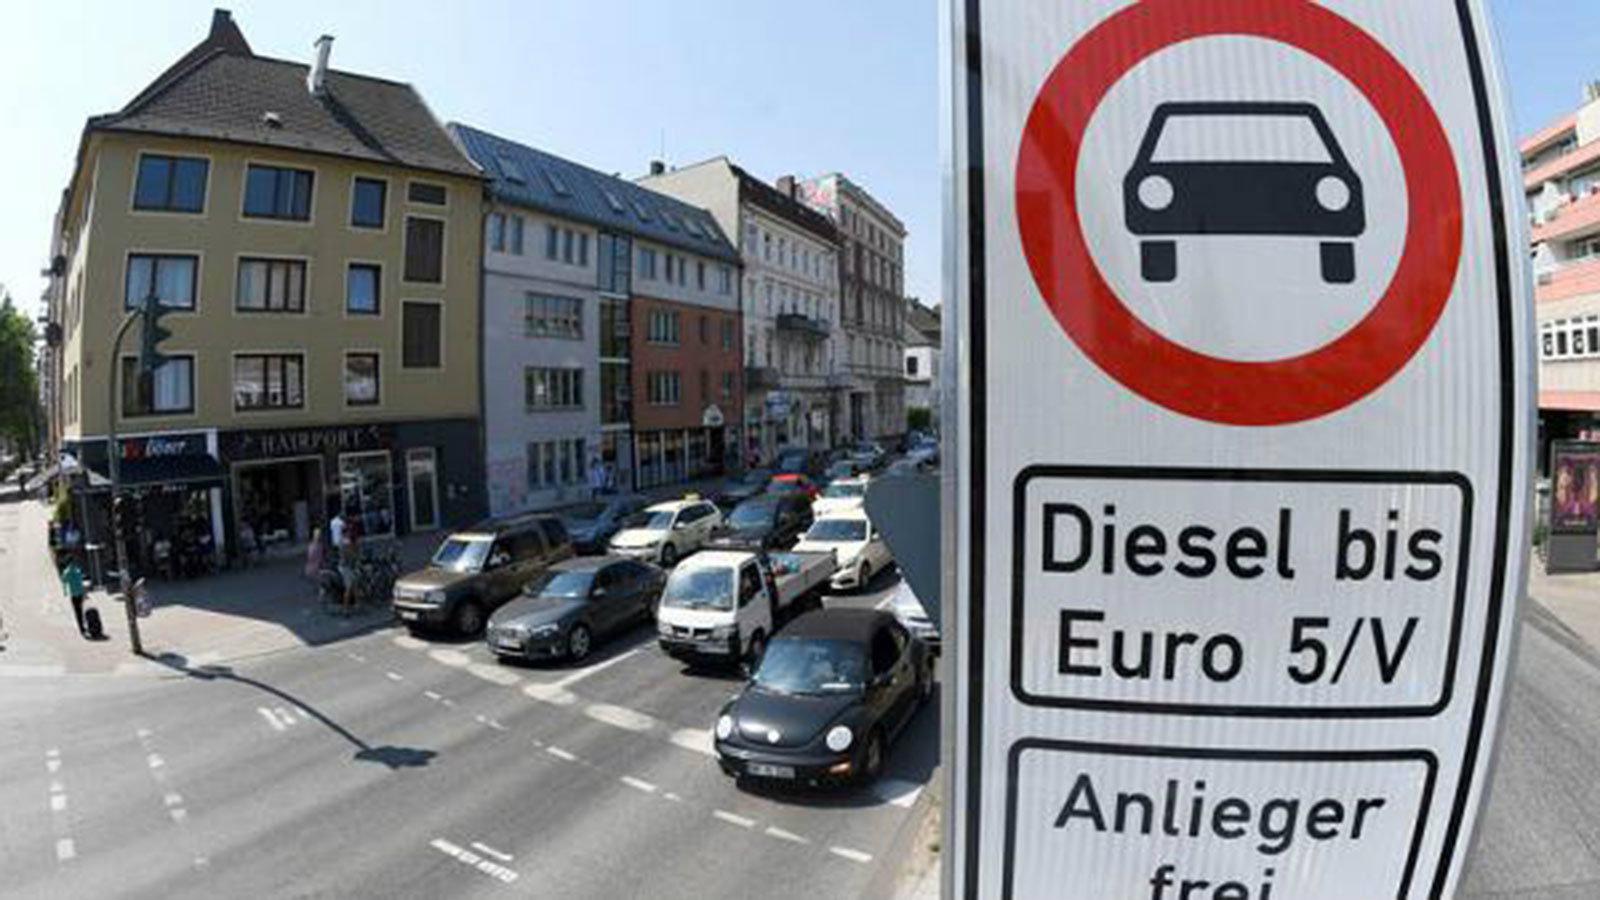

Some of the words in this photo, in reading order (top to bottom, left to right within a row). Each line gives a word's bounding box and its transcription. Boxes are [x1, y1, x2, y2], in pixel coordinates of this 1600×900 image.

[1041, 502, 1295, 580] Diesel
[1335, 508, 1443, 582] bis
[1057, 608, 1244, 683] Euro
[1287, 616, 1420, 685] 5/V
[1054, 773, 1386, 856] Anlieger
